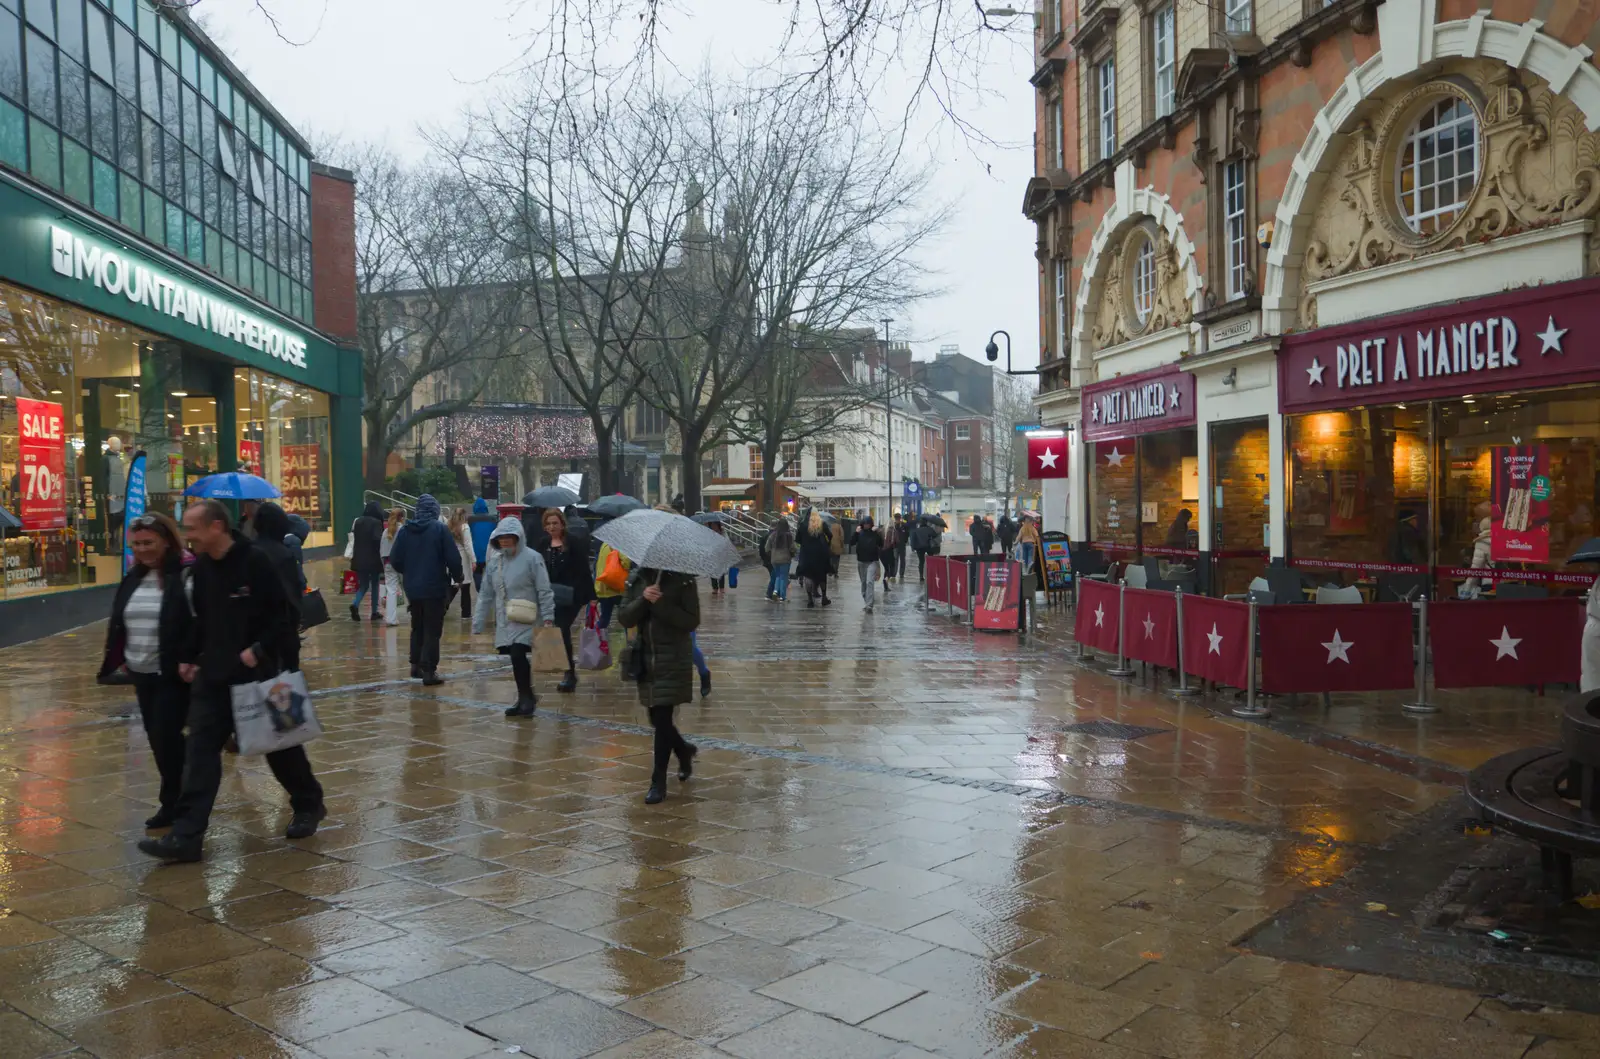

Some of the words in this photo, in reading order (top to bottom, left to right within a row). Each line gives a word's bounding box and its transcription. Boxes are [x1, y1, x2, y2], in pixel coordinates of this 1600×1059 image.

[75, 238, 208, 330] MOUNTAIN
[209, 302, 307, 369] WAREHOUSE
[1222, 322, 1249, 337] HAYMARKET
[1337, 338, 1386, 388] PRET
[1394, 335, 1408, 381] A
[1417, 316, 1519, 377] MANGER
[1103, 391, 1121, 424] PRET
[1123, 390, 1129, 421] A
[1130, 383, 1165, 420] MANGER
[22, 413, 60, 439] SALE
[281, 454, 318, 471] SALE
[282, 475, 318, 492] SALE
[283, 495, 320, 512] SALE
[6, 555, 20, 568] FOR
[1299, 559, 1323, 567] BAGUETTES
[1328, 561, 1357, 569] SANDWICHES
[1362, 563, 1391, 571] CROISSANTS
[7, 566, 42, 581] EVERYDAY
[1456, 569, 1492, 577] CAPPUCCINO
[1501, 571, 1540, 580] CROISSANTS
[1554, 574, 1593, 583] BAGUETTES
